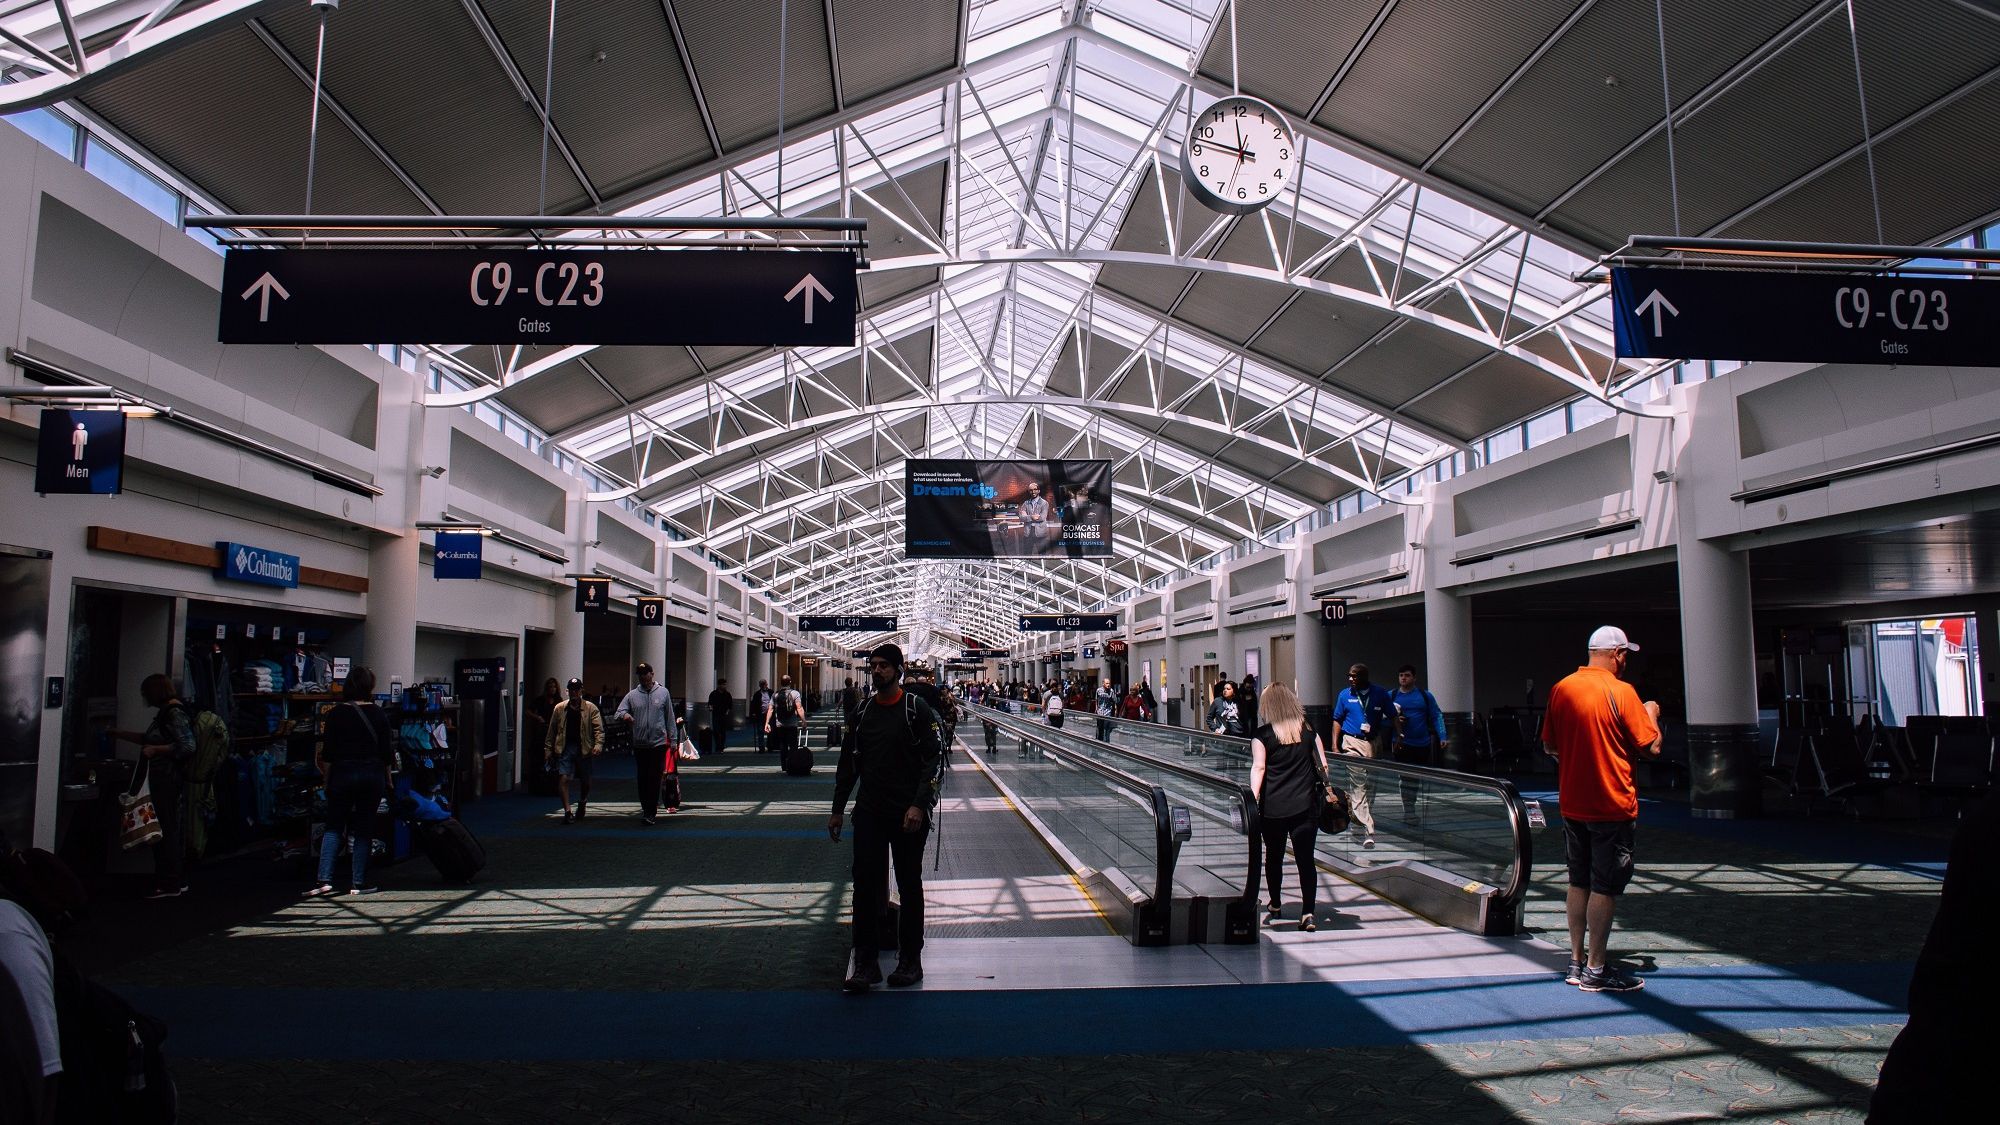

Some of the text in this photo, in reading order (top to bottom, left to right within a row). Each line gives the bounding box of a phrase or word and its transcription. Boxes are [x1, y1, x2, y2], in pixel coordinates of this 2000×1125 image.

[1212, 111, 1225, 122] 11
[1231, 105, 1247, 117] 12
[1258, 112, 1265, 124] 1
[1198, 126, 1214, 138] 10
[1273, 128, 1282, 139] 2
[1193, 144, 1202, 156] 9
[1279, 148, 1289, 160] 3
[1199, 165, 1209, 177] 8
[1273, 168, 1283, 180] 4
[1216, 181, 1226, 193] 7
[1237, 187, 1247, 199] 6
[1258, 183, 1268, 194] 5
[470, 262, 604, 307] C9-C23
[1835, 287, 1949, 330] C9-C23
[518, 317, 551, 333] Gates
[1880, 338, 1909, 355] Gates
[66, 464, 89, 478] Men
[913, 482, 998, 499] Dream Gig.
[1062, 524, 1100, 532] COMCAST
[1062, 531, 1101, 539] BUSINESS
[444, 550, 478, 560] Columbia
[247, 551, 293, 581] Columbia
[643, 604, 657, 620] C9
[1325, 605, 1344, 620] C10
[836, 618, 860, 627] C11-C23
[1056, 617, 1081, 626] C11-C23
[764, 641, 775, 650] C11
[1109, 642, 1125, 653] Spa
